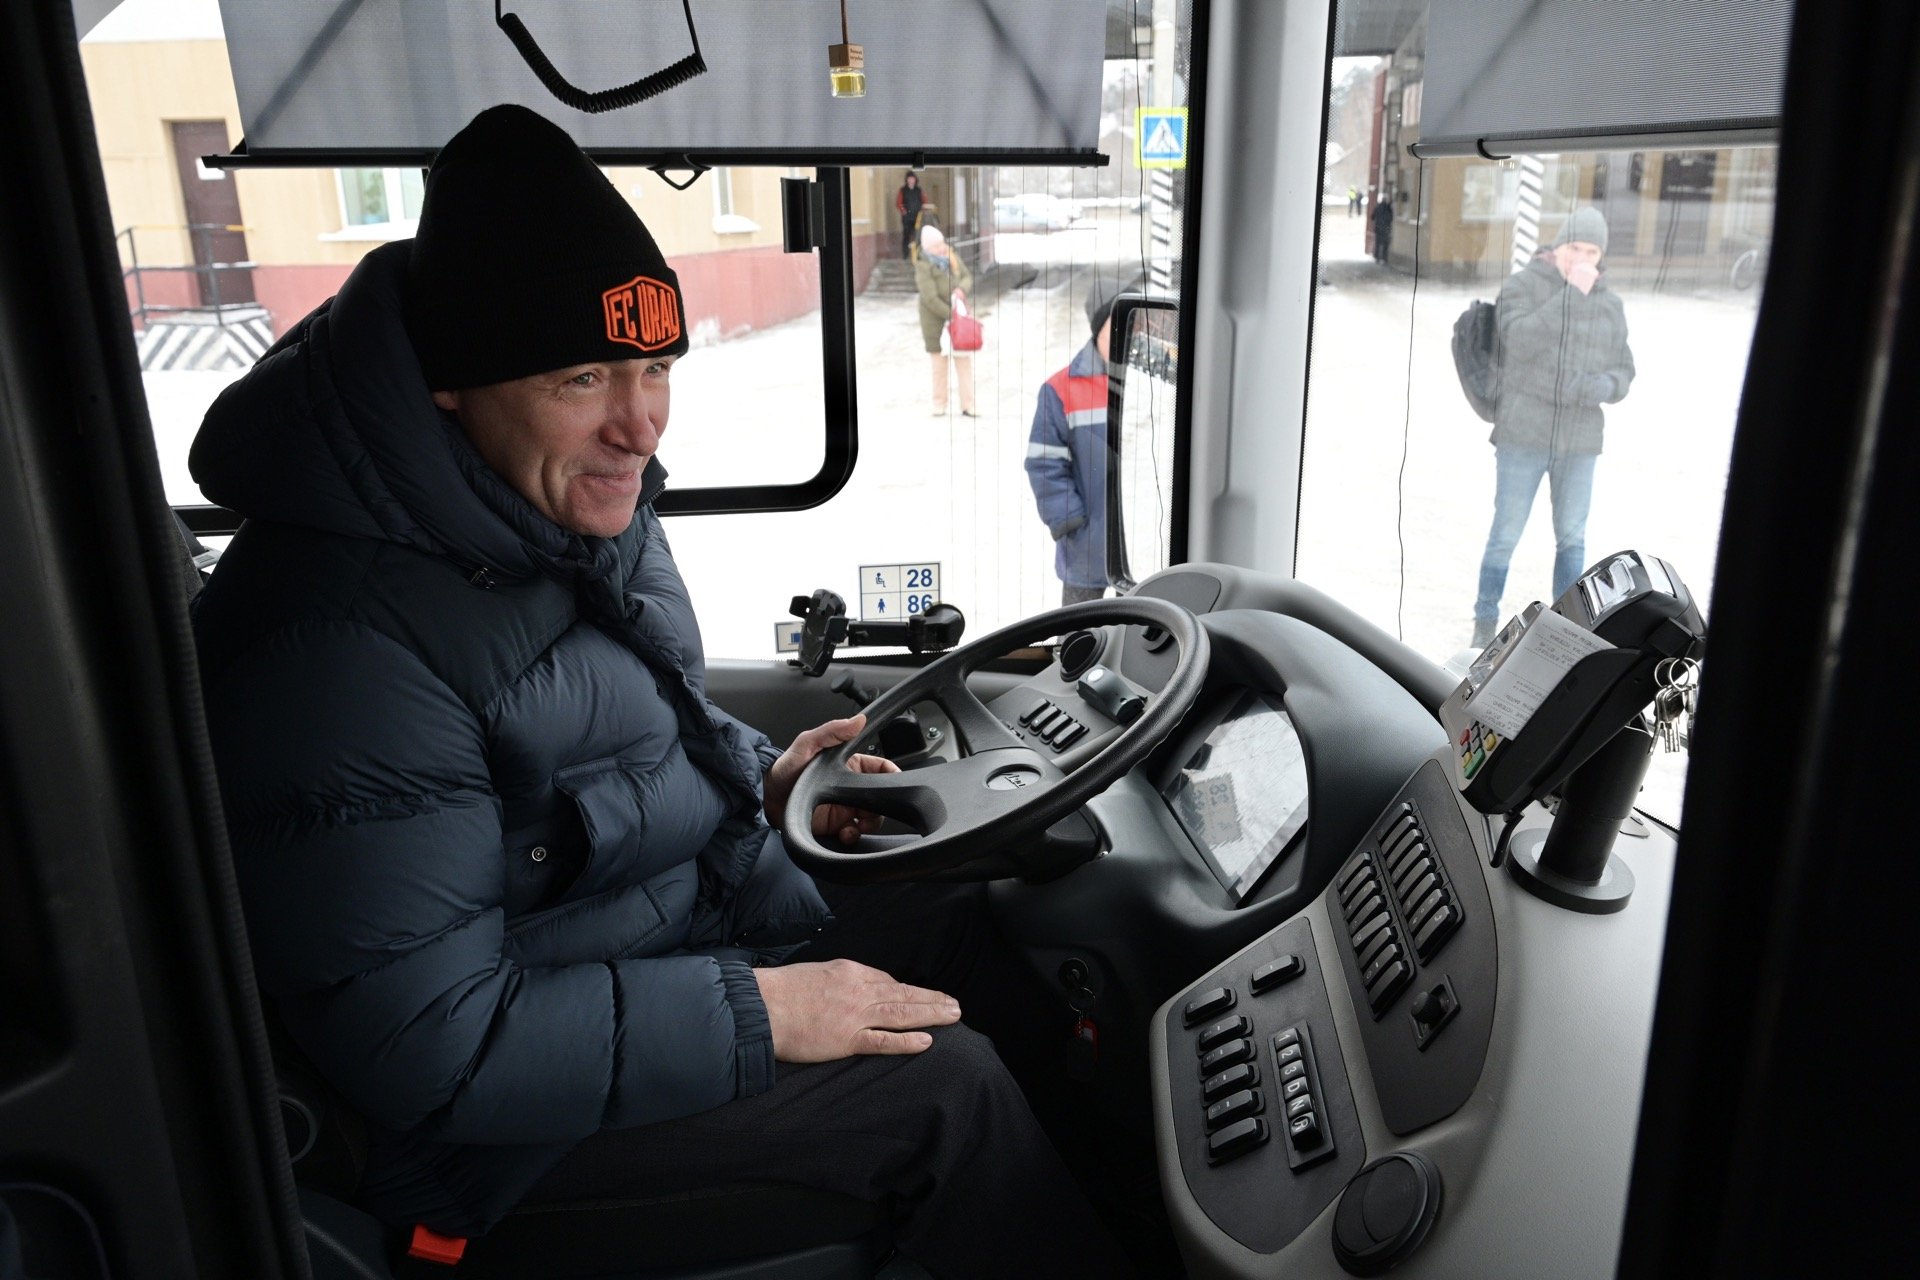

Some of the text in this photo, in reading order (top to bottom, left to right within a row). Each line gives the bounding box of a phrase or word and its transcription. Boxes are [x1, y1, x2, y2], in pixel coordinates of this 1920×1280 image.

[608, 282, 680, 344] FC URAL
[906, 568, 933, 588] 28
[907, 594, 934, 614] 86
[1278, 1034, 1309, 1131] 1 2 3 D N R
